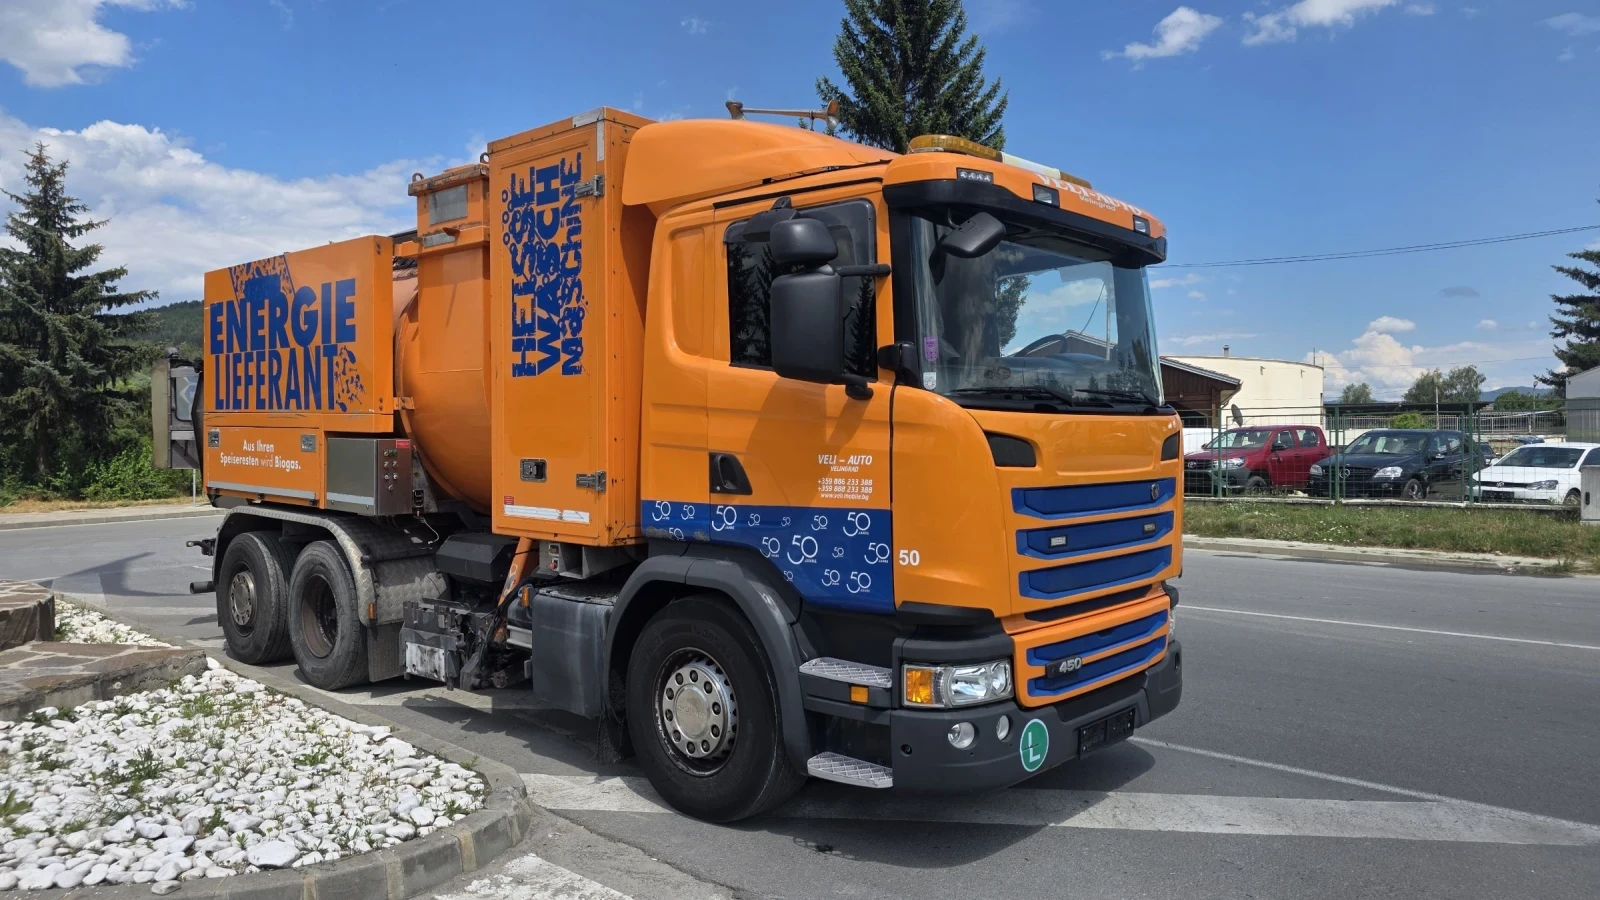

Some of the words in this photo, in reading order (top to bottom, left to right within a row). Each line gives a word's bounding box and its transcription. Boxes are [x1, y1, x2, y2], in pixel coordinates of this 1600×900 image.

[1078, 194, 1116, 211] Velingrad
[511, 166, 537, 377] HEISSE
[536, 164, 561, 375] WASCH
[210, 278, 356, 355] ENERGIE
[215, 344, 338, 410] LIEFERANT
[243, 440, 254, 451] Aus
[257, 440, 274, 452] Ihren
[220, 452, 259, 467] Speiseresten
[260, 455, 273, 467] wird
[275, 456, 301, 472] Biogas.
[818, 454, 837, 464] VELI
[847, 455, 872, 465] AUTO
[830, 465, 859, 473] VELINGRAD
[652, 501, 671, 521] 50
[681, 505, 695, 520] 50
[712, 505, 737, 531] 50
[747, 513, 760, 527] 50
[781, 517, 791, 526] 50
[811, 515, 828, 530] 50
[843, 512, 871, 536] 50
[760, 537, 780, 558] 50
[787, 535, 818, 565] 50
[832, 547, 844, 558] 50
[864, 542, 890, 565] 50
[899, 549, 920, 566] 50
[821, 569, 840, 586] 50
[846, 571, 871, 594] 50
[1059, 657, 1082, 674] 450
[1028, 731, 1041, 763] L
